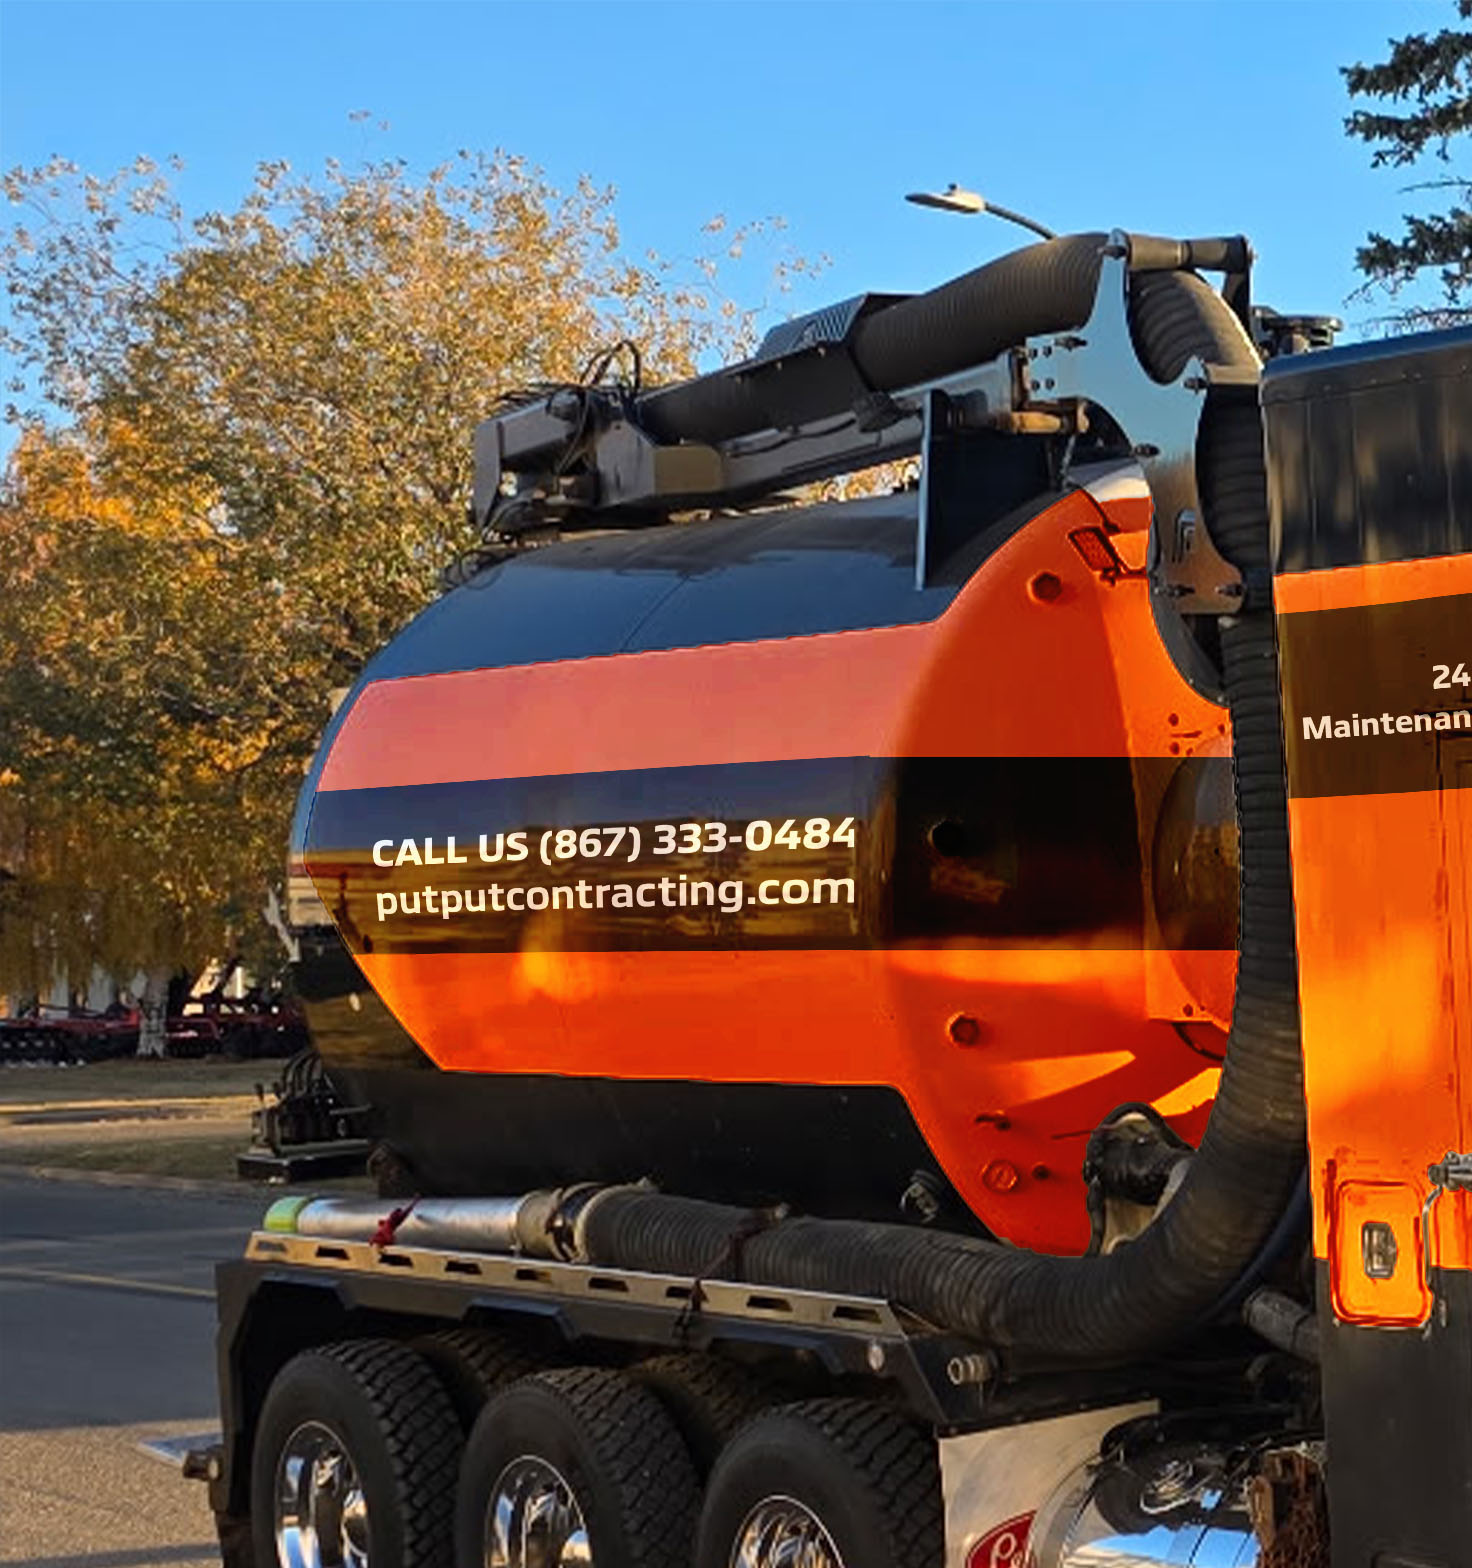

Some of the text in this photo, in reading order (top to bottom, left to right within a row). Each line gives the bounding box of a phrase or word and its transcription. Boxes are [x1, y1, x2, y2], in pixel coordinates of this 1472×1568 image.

[1432, 663, 1471, 690] 24
[372, 816, 855, 868] CALL US (867) 333-0484
[376, 874, 855, 922] putputcontracting.com
